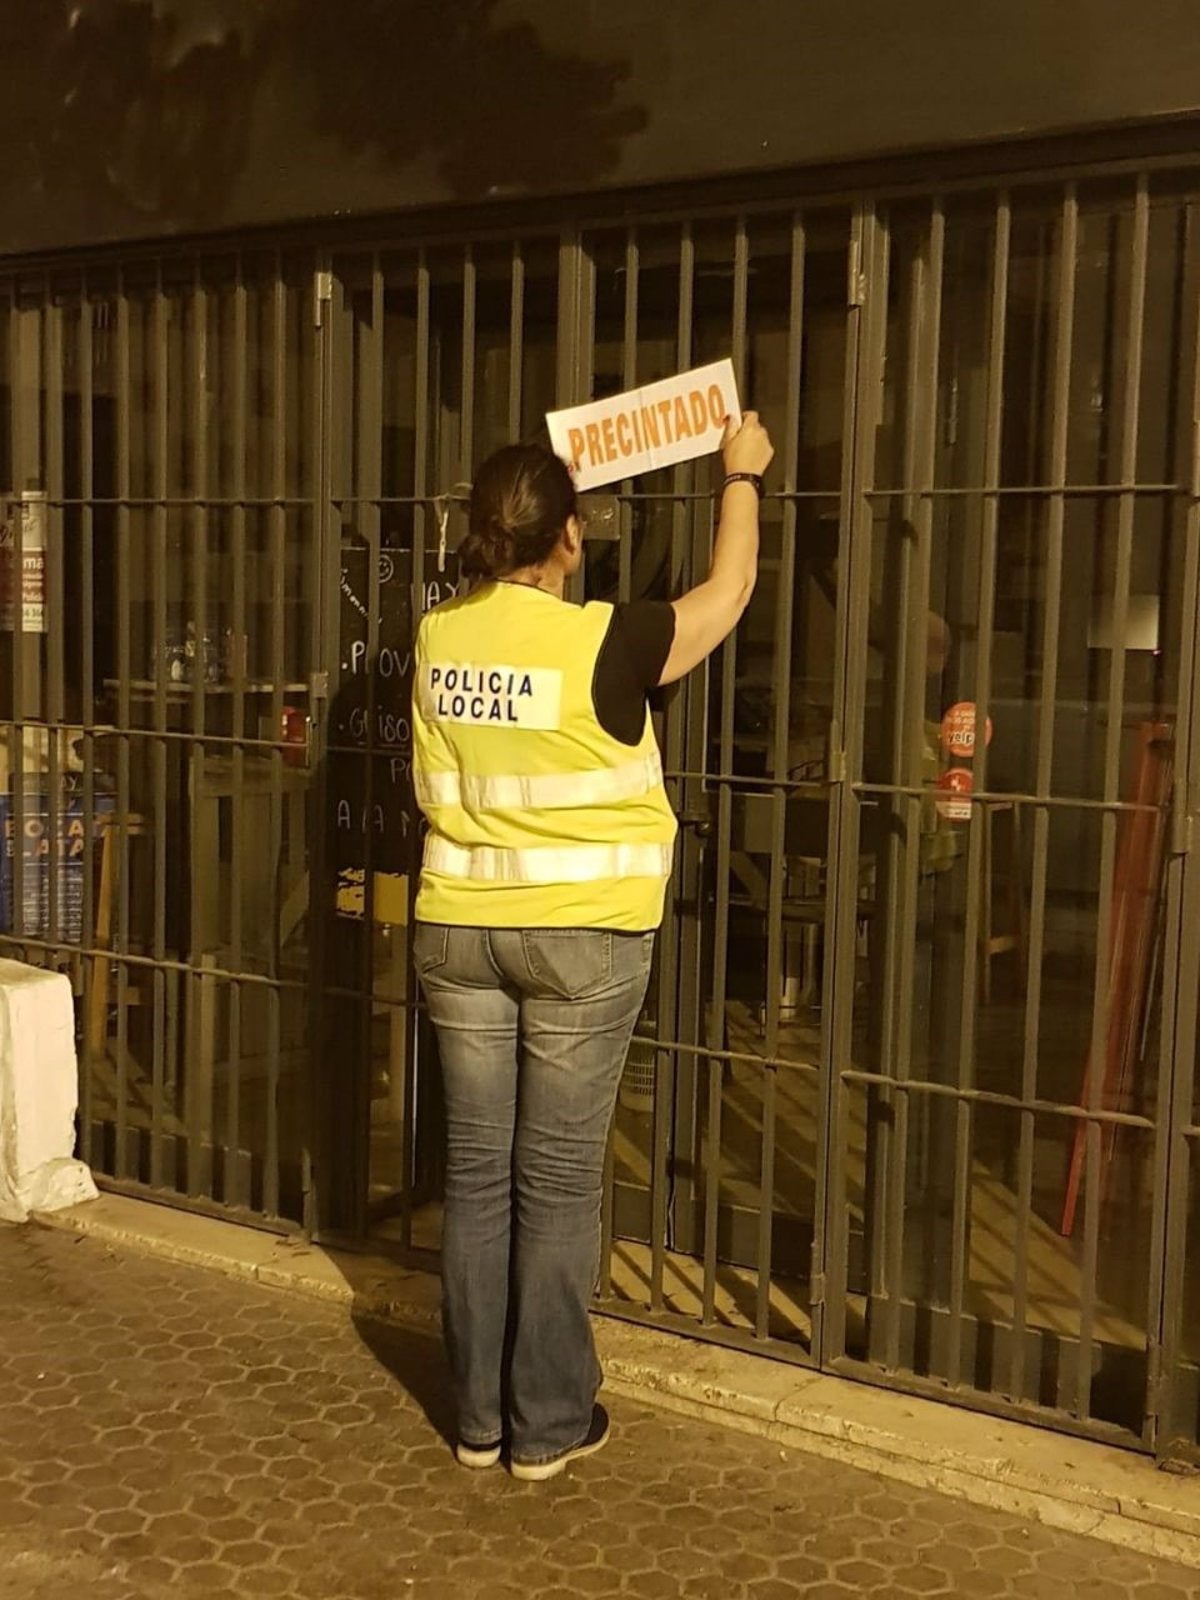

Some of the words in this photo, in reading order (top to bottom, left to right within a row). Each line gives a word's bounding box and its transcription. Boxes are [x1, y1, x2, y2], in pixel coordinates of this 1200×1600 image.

[568, 384, 727, 473] PRECINTADO
[431, 668, 533, 696] POLICIA
[438, 694, 518, 722] LOCAL
